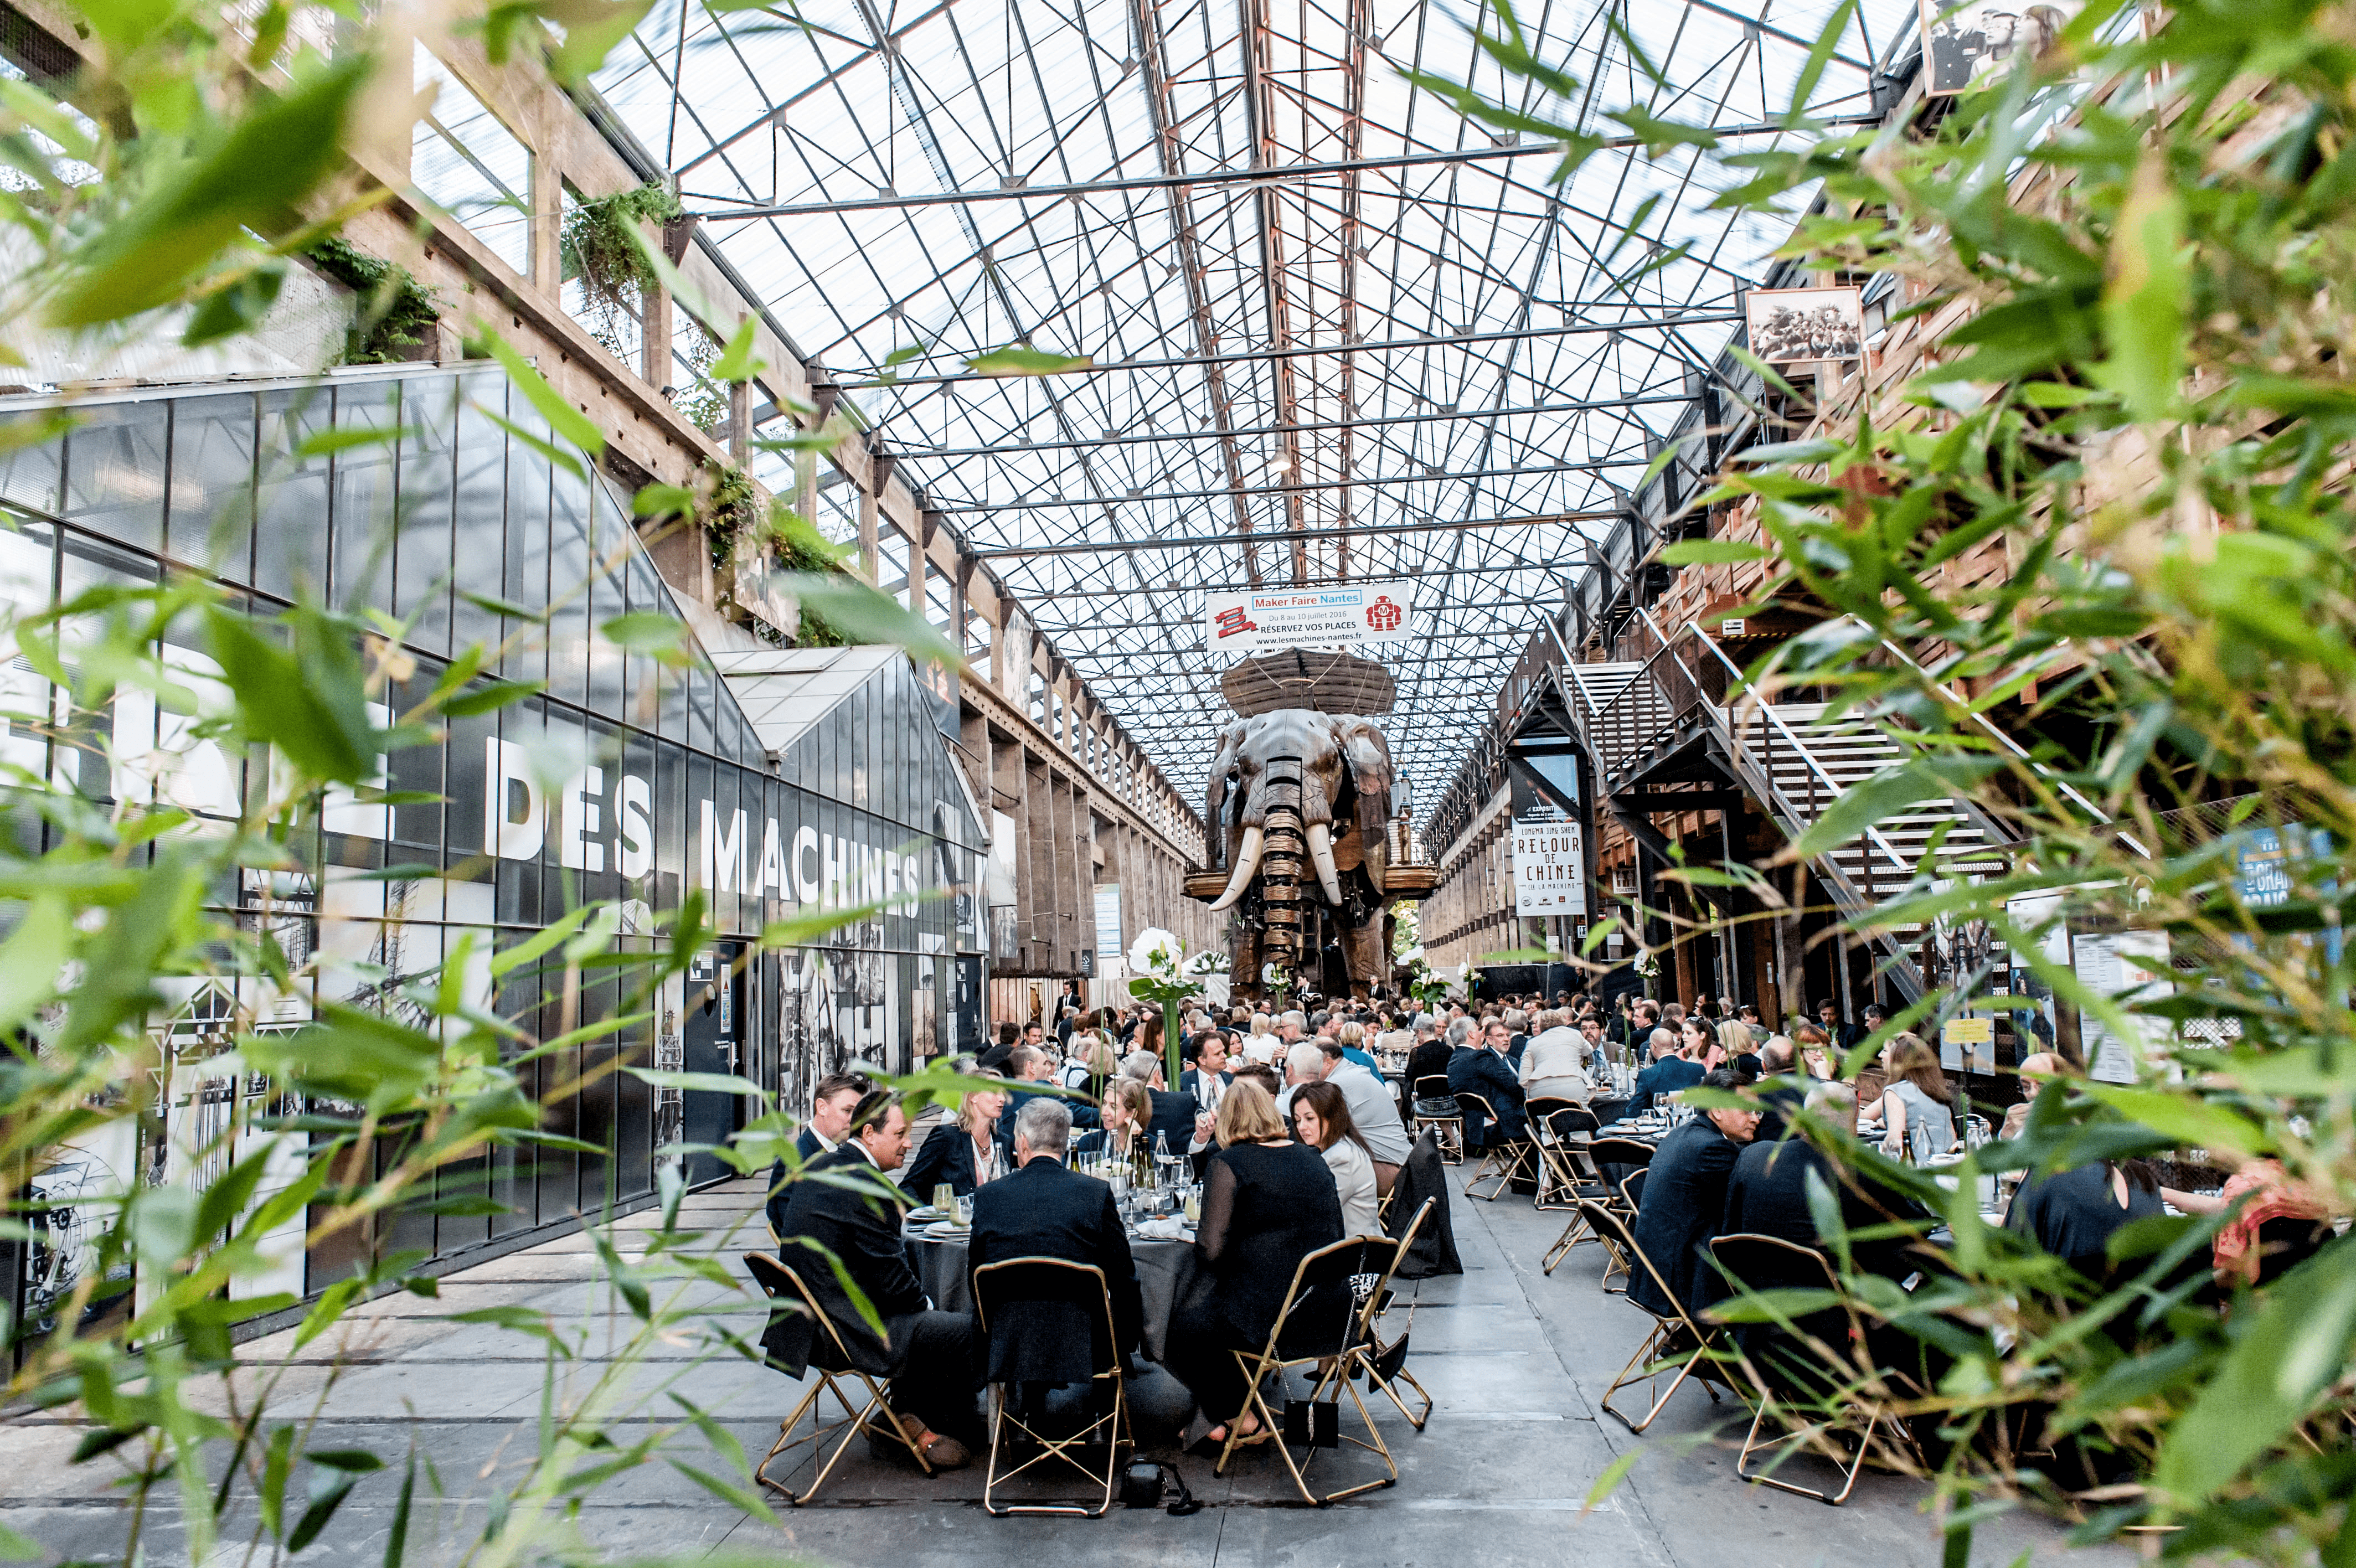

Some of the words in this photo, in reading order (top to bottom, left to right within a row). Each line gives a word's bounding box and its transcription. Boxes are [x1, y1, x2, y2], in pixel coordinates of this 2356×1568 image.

[1255, 599, 1288, 607] Maker
[1292, 596, 1317, 605] Faire
[1320, 594, 1358, 604] Nantes
[1261, 624, 1302, 633] RÉSERVEZ
[1325, 621, 1356, 630] PLACES
[1256, 632, 1362, 644] www.lesmachines-nantes.fr
[485, 736, 652, 879] DES
[701, 799, 919, 919] MACHINES
[1545, 853, 1556, 864] DE
[1527, 864, 1575, 880] CHINE
